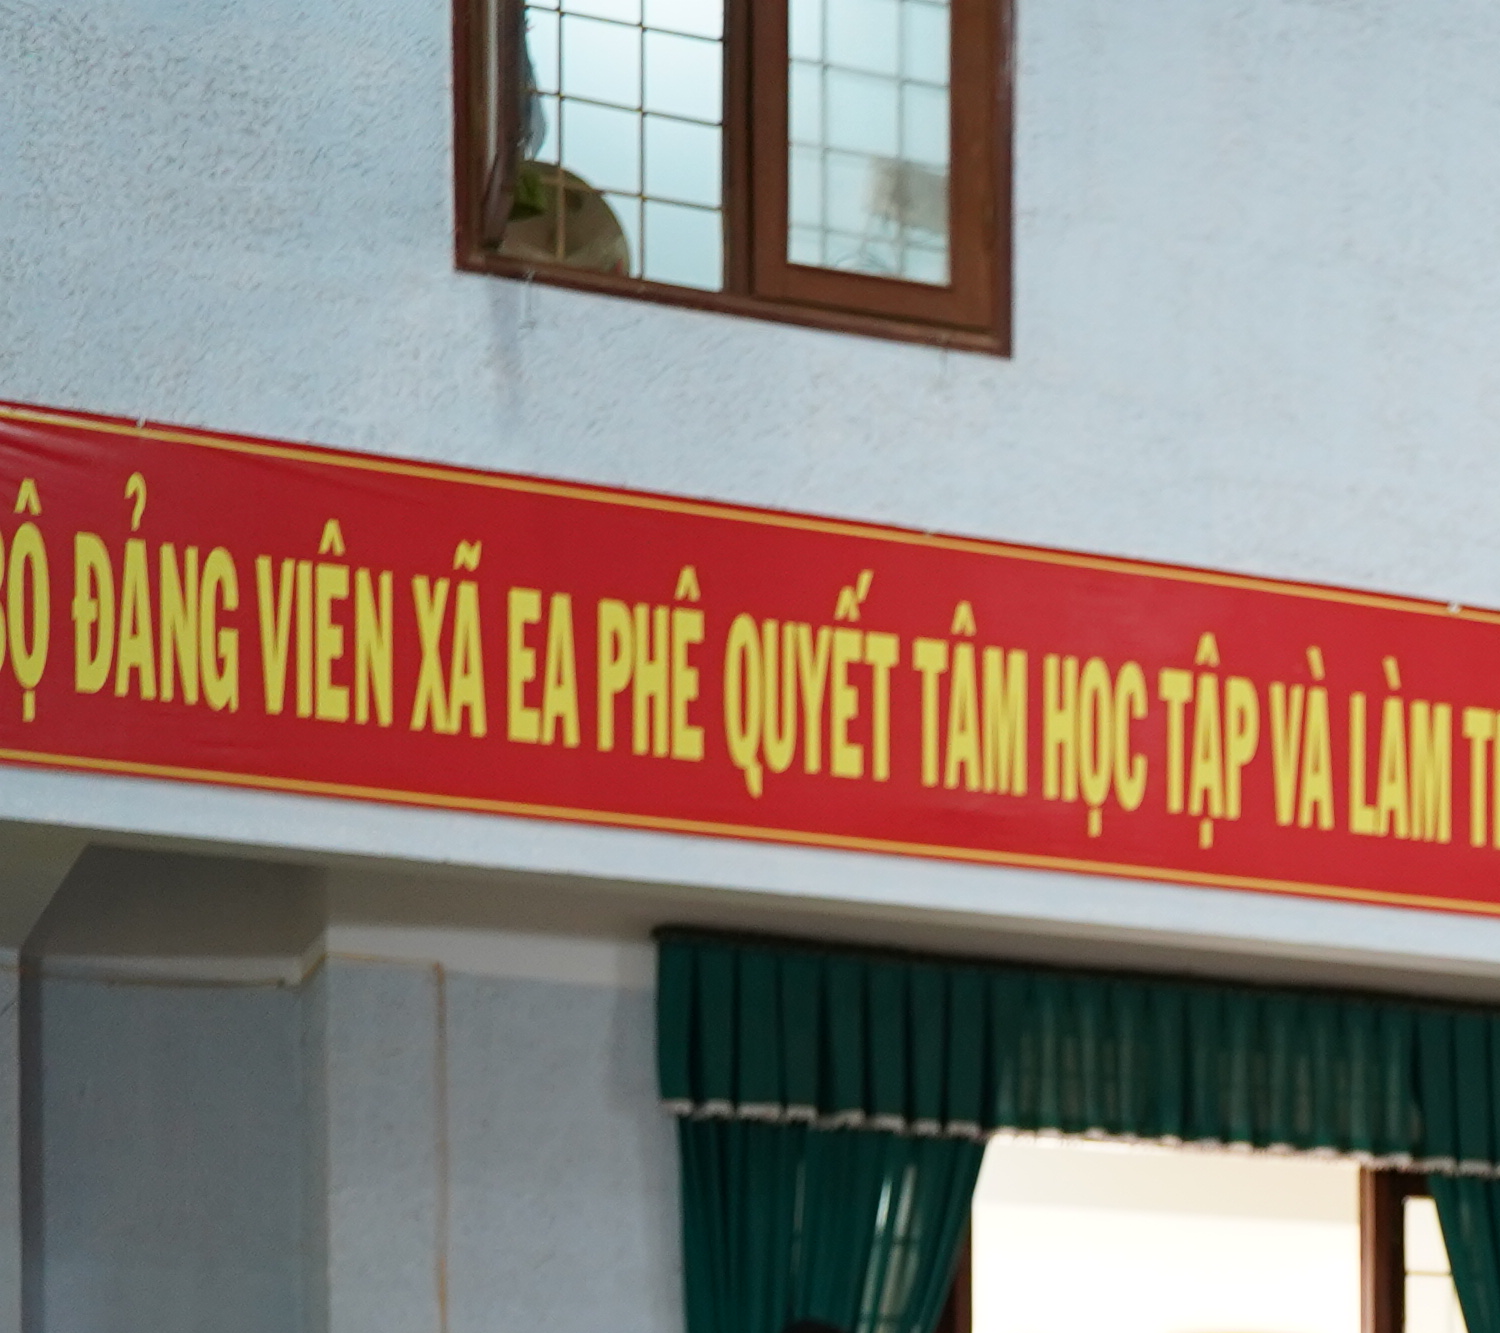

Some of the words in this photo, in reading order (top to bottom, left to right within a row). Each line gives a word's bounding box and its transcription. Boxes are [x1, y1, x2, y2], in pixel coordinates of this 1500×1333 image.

[0, 479, 49, 721] Ộ
[73, 473, 238, 712] ĐẢNG
[257, 520, 392, 726] VIÊN
[411, 542, 486, 737] XÃ
[508, 588, 579, 747] EA
[598, 567, 703, 760] PHÊ
[724, 570, 899, 796] QUYẾT
[913, 602, 1027, 796] TÂM
[1043, 654, 1147, 837] HỌC
[1159, 633, 1259, 848] TẬP
[1270, 647, 1334, 830] VÀ
[1350, 657, 1451, 843] LÀM
